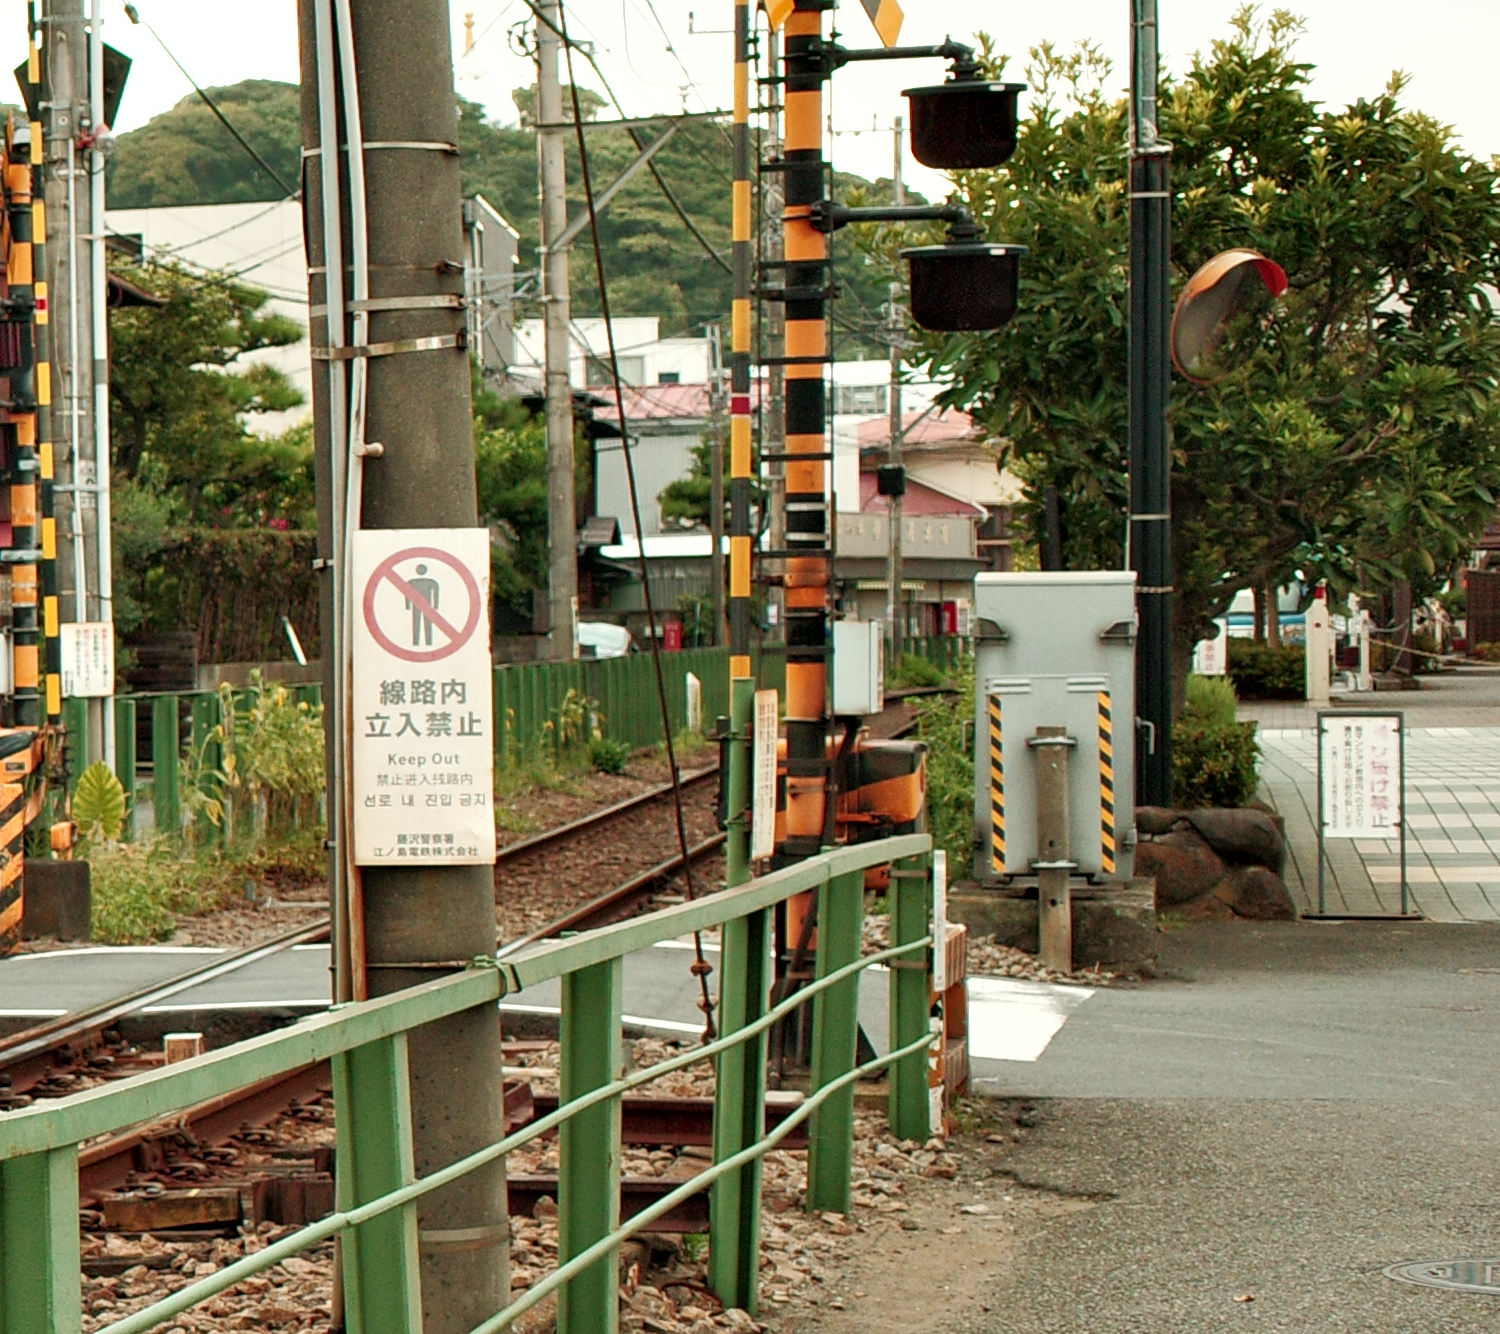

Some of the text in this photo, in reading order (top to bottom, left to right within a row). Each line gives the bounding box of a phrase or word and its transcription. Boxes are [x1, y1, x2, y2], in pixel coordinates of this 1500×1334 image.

[379, 679, 467, 706] 線路内
[364, 711, 483, 738] 立入禁止
[388, 752, 460, 768] Keep Out
[364, 793, 486, 808] 선로 내 진입 금지
